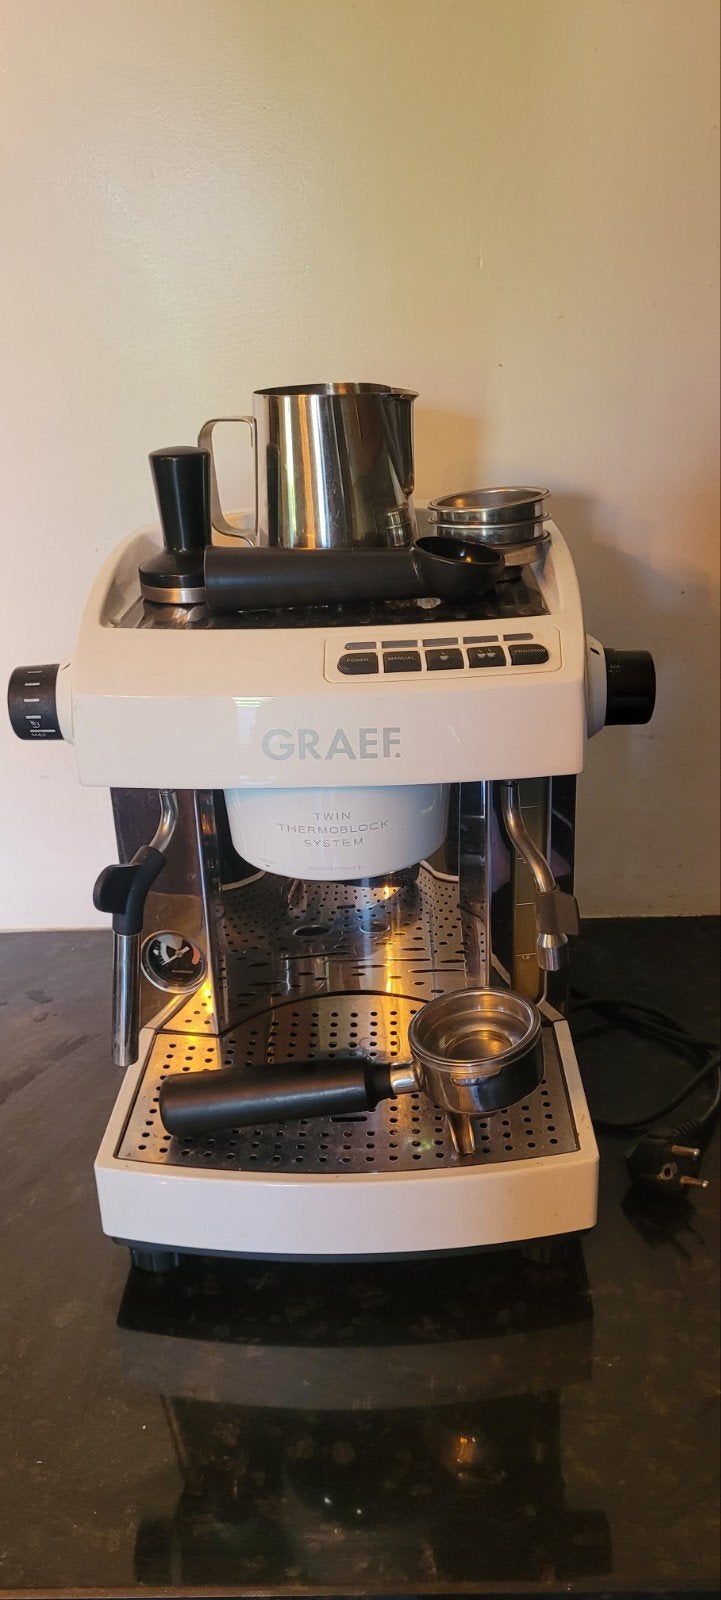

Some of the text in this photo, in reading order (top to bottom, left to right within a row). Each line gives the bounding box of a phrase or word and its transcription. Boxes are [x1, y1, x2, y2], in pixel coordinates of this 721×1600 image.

[261, 727, 401, 761] GRAEF
[313, 812, 352, 821] TWIN
[276, 819, 391, 834] THERMOBLOCK
[303, 837, 365, 848] SYSTEM
